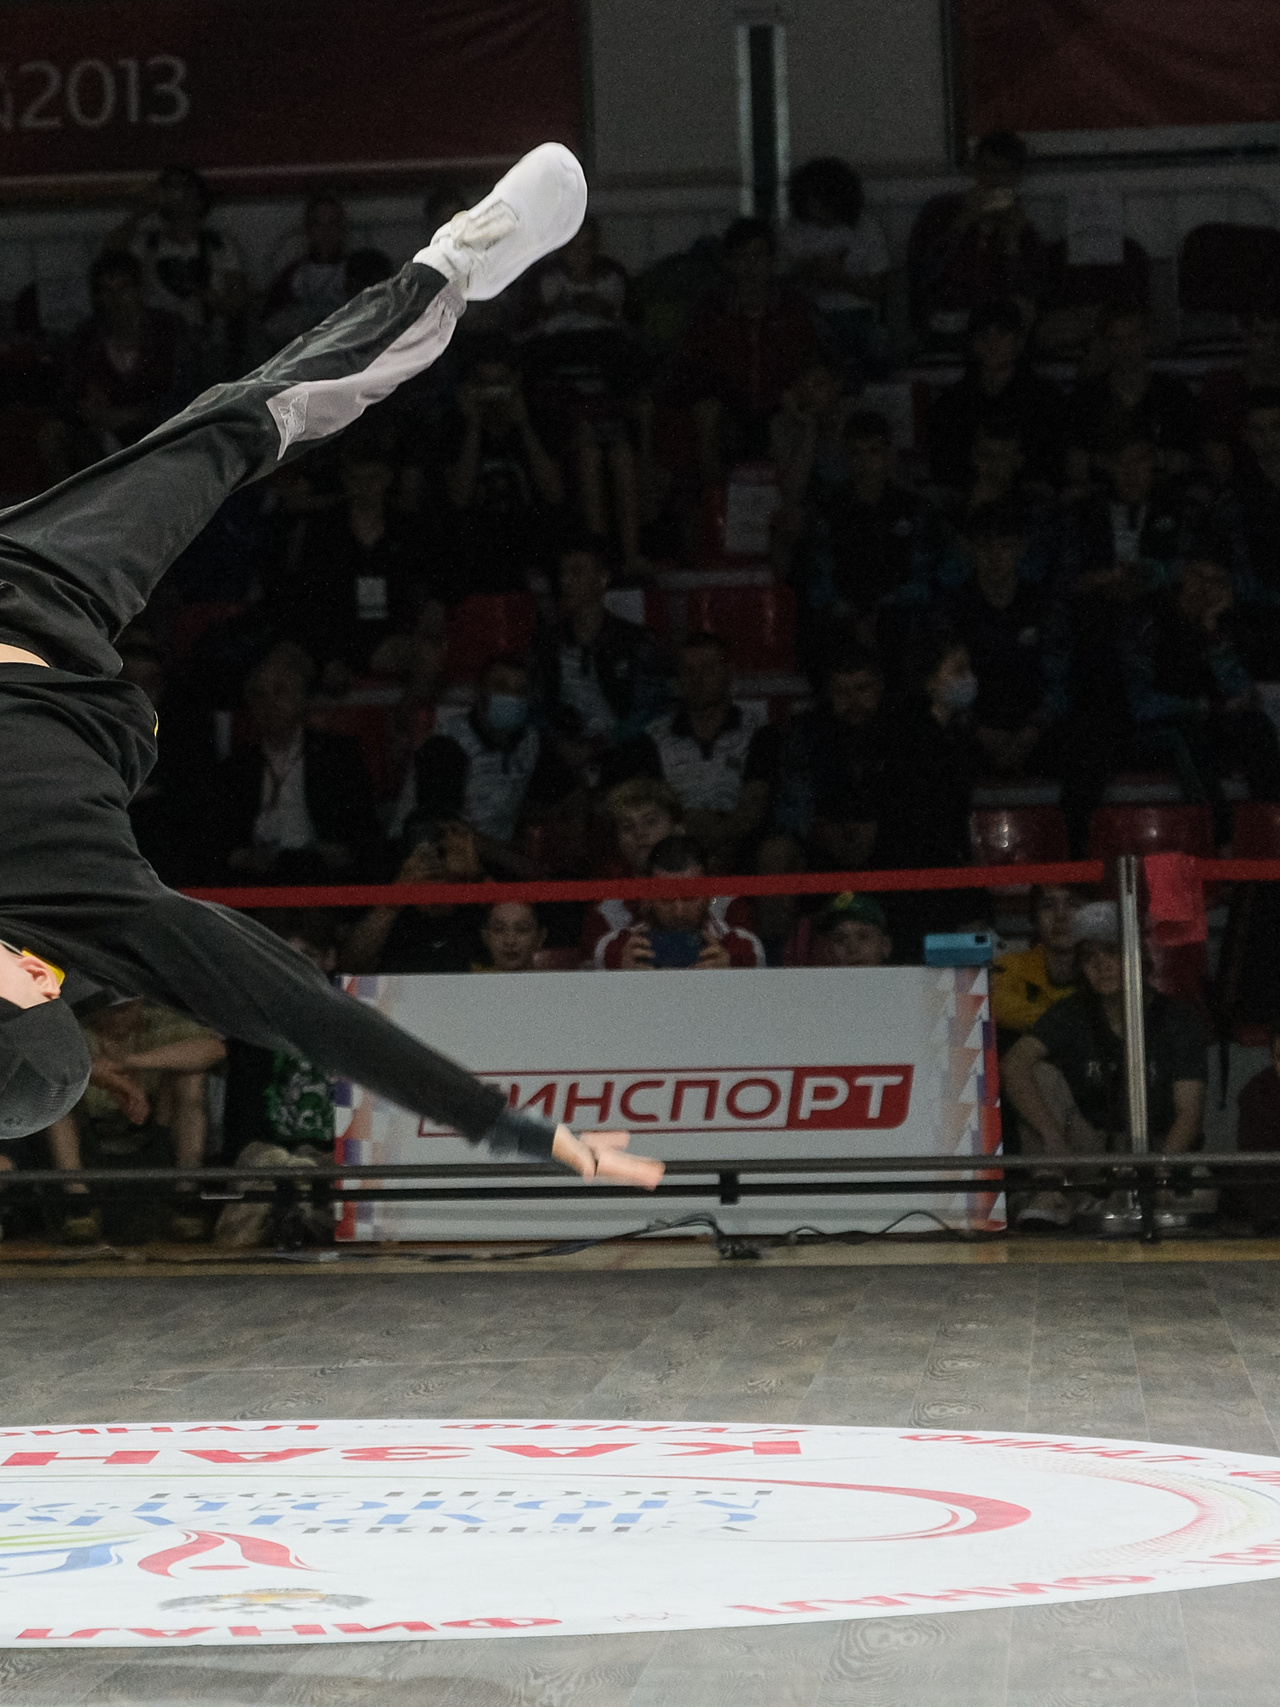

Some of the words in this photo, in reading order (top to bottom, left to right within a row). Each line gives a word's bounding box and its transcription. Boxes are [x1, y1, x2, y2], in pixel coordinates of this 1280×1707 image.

[19, 53, 192, 131] 2013
[507, 1074, 904, 1125] ИНСПОРТ
[441, 1423, 810, 1434] ФИНАЛ
[899, 1434, 1207, 1462] ФИНАЛ
[16, 1617, 563, 1640] ФИНАЛ
